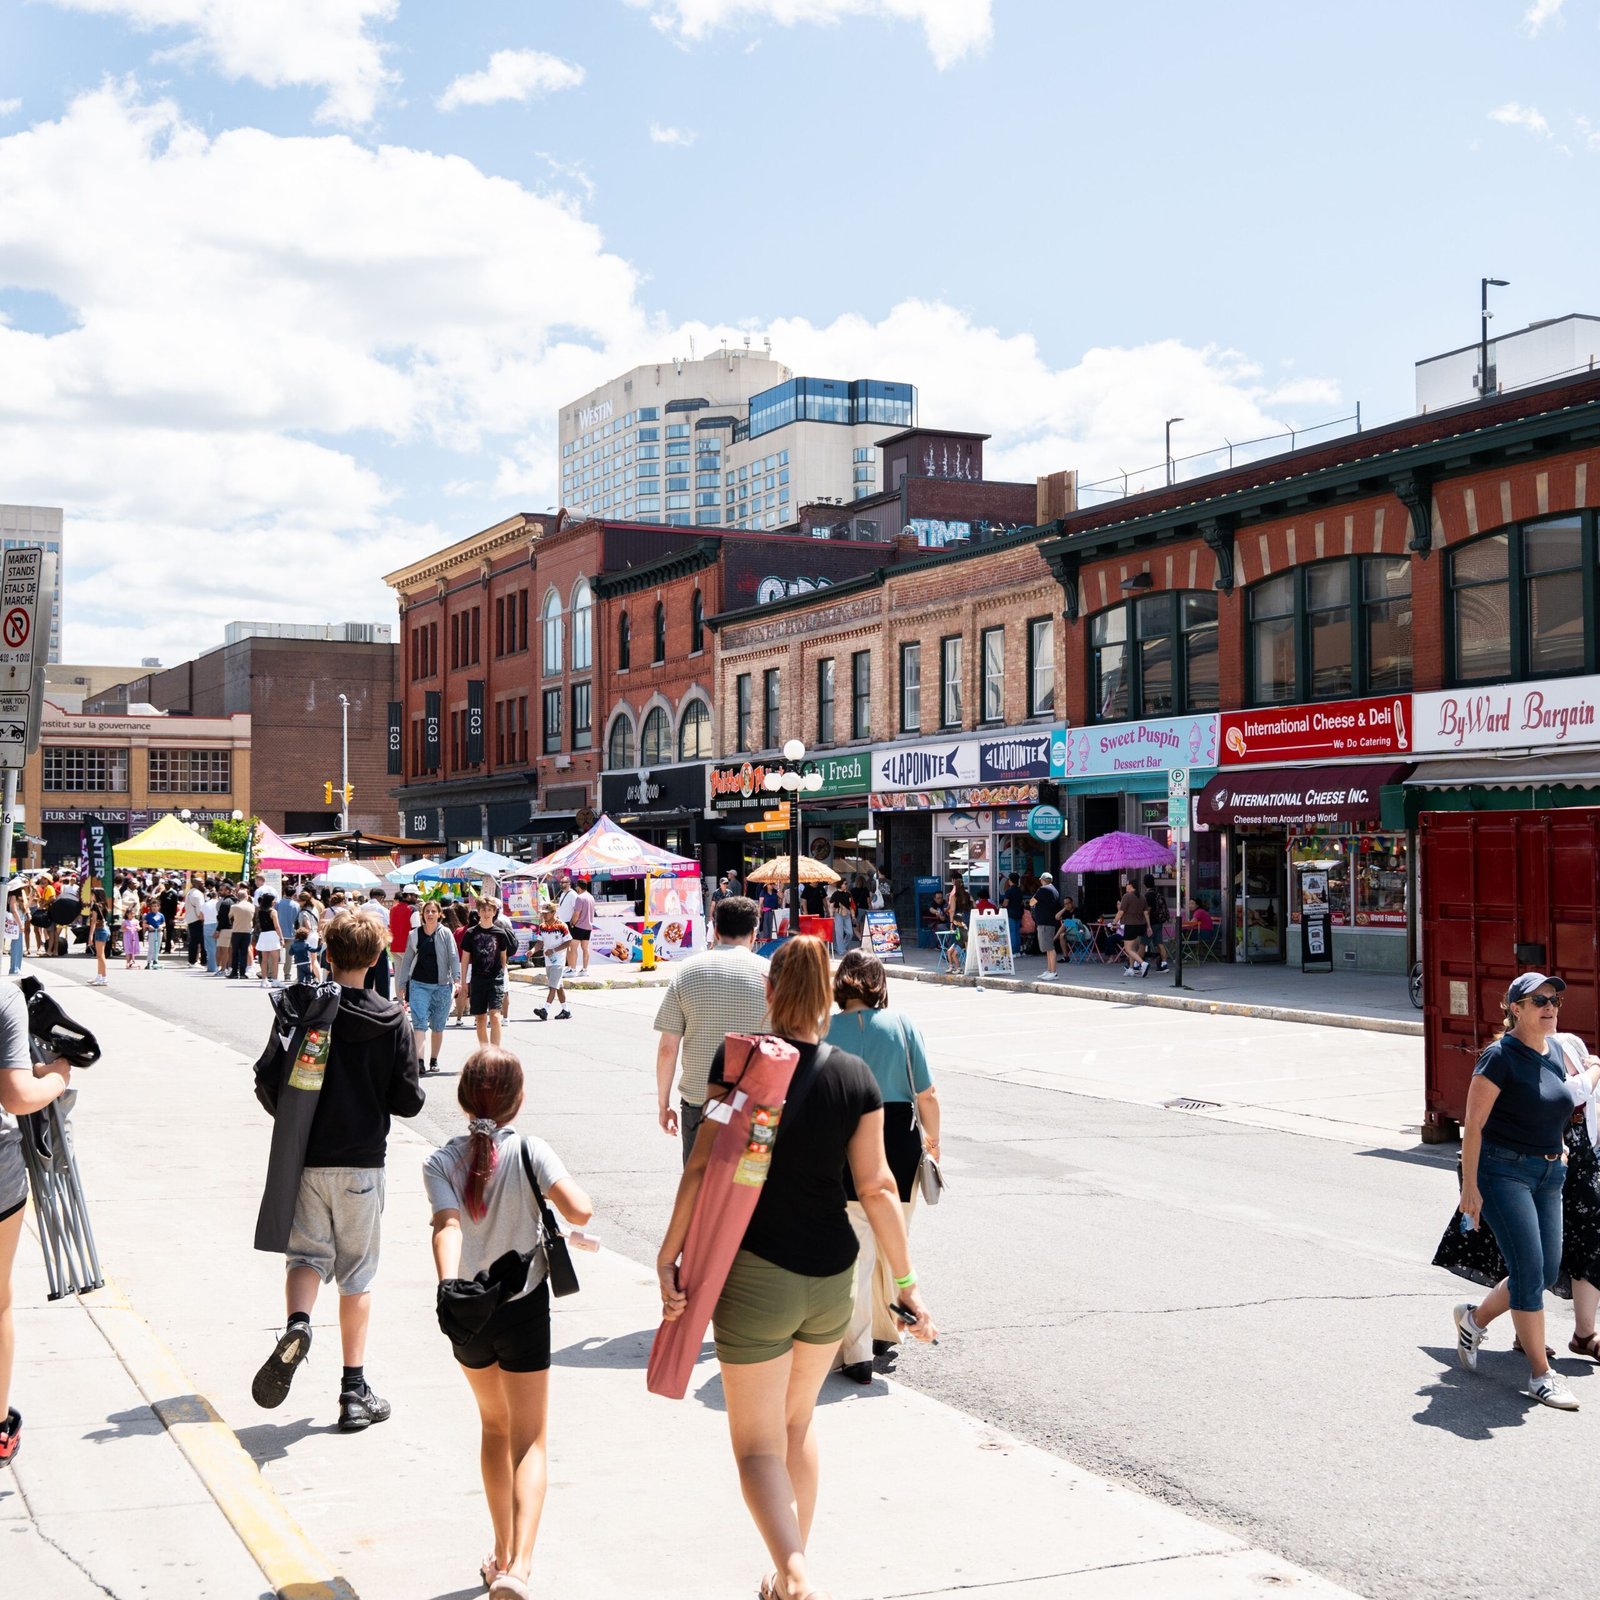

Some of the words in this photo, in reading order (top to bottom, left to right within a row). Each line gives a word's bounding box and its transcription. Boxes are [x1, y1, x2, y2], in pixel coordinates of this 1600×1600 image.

[579, 400, 613, 430] WESTIN
[8, 554, 37, 564] MARKET
[8, 566, 35, 577] STANDS
[27, 583, 36, 592] DE
[89, 720, 96, 728] la
[98, 721, 151, 731] gouvernance
[470, 708, 481, 735] EQ3
[1244, 714, 1310, 737] International
[1313, 713, 1355, 731] Cheese
[1358, 712, 1366, 727] &
[1369, 707, 1391, 726] Deli
[1520, 691, 1595, 740] Bargain
[390, 726, 400, 750] EQ3
[428, 717, 438, 743] EQ3
[1100, 730, 1135, 754] Sweet
[1137, 725, 1180, 751] Puspin
[1333, 739, 1344, 749] We
[1347, 738, 1357, 748] Do
[1360, 736, 1391, 747] Catering
[829, 757, 862, 781] Fresh
[892, 751, 945, 786] LAPOINTE
[993, 744, 1037, 771] LAPOINTE
[1114, 757, 1145, 770] Dessert
[1146, 756, 1162, 768] Bar
[1230, 792, 1302, 807] INTERNATIONAL
[1305, 789, 1346, 805] CHEESE
[1348, 788, 1369, 803] INC.
[45, 811, 65, 820] FUR
[414, 815, 427, 831] EQ3
[1233, 815, 1261, 824] Cheeses
[1262, 815, 1278, 823] from
[1278, 814, 1304, 823] Around
[1304, 814, 1316, 823] the
[1317, 813, 1338, 822] World
[91, 826, 105, 878] ENTER
